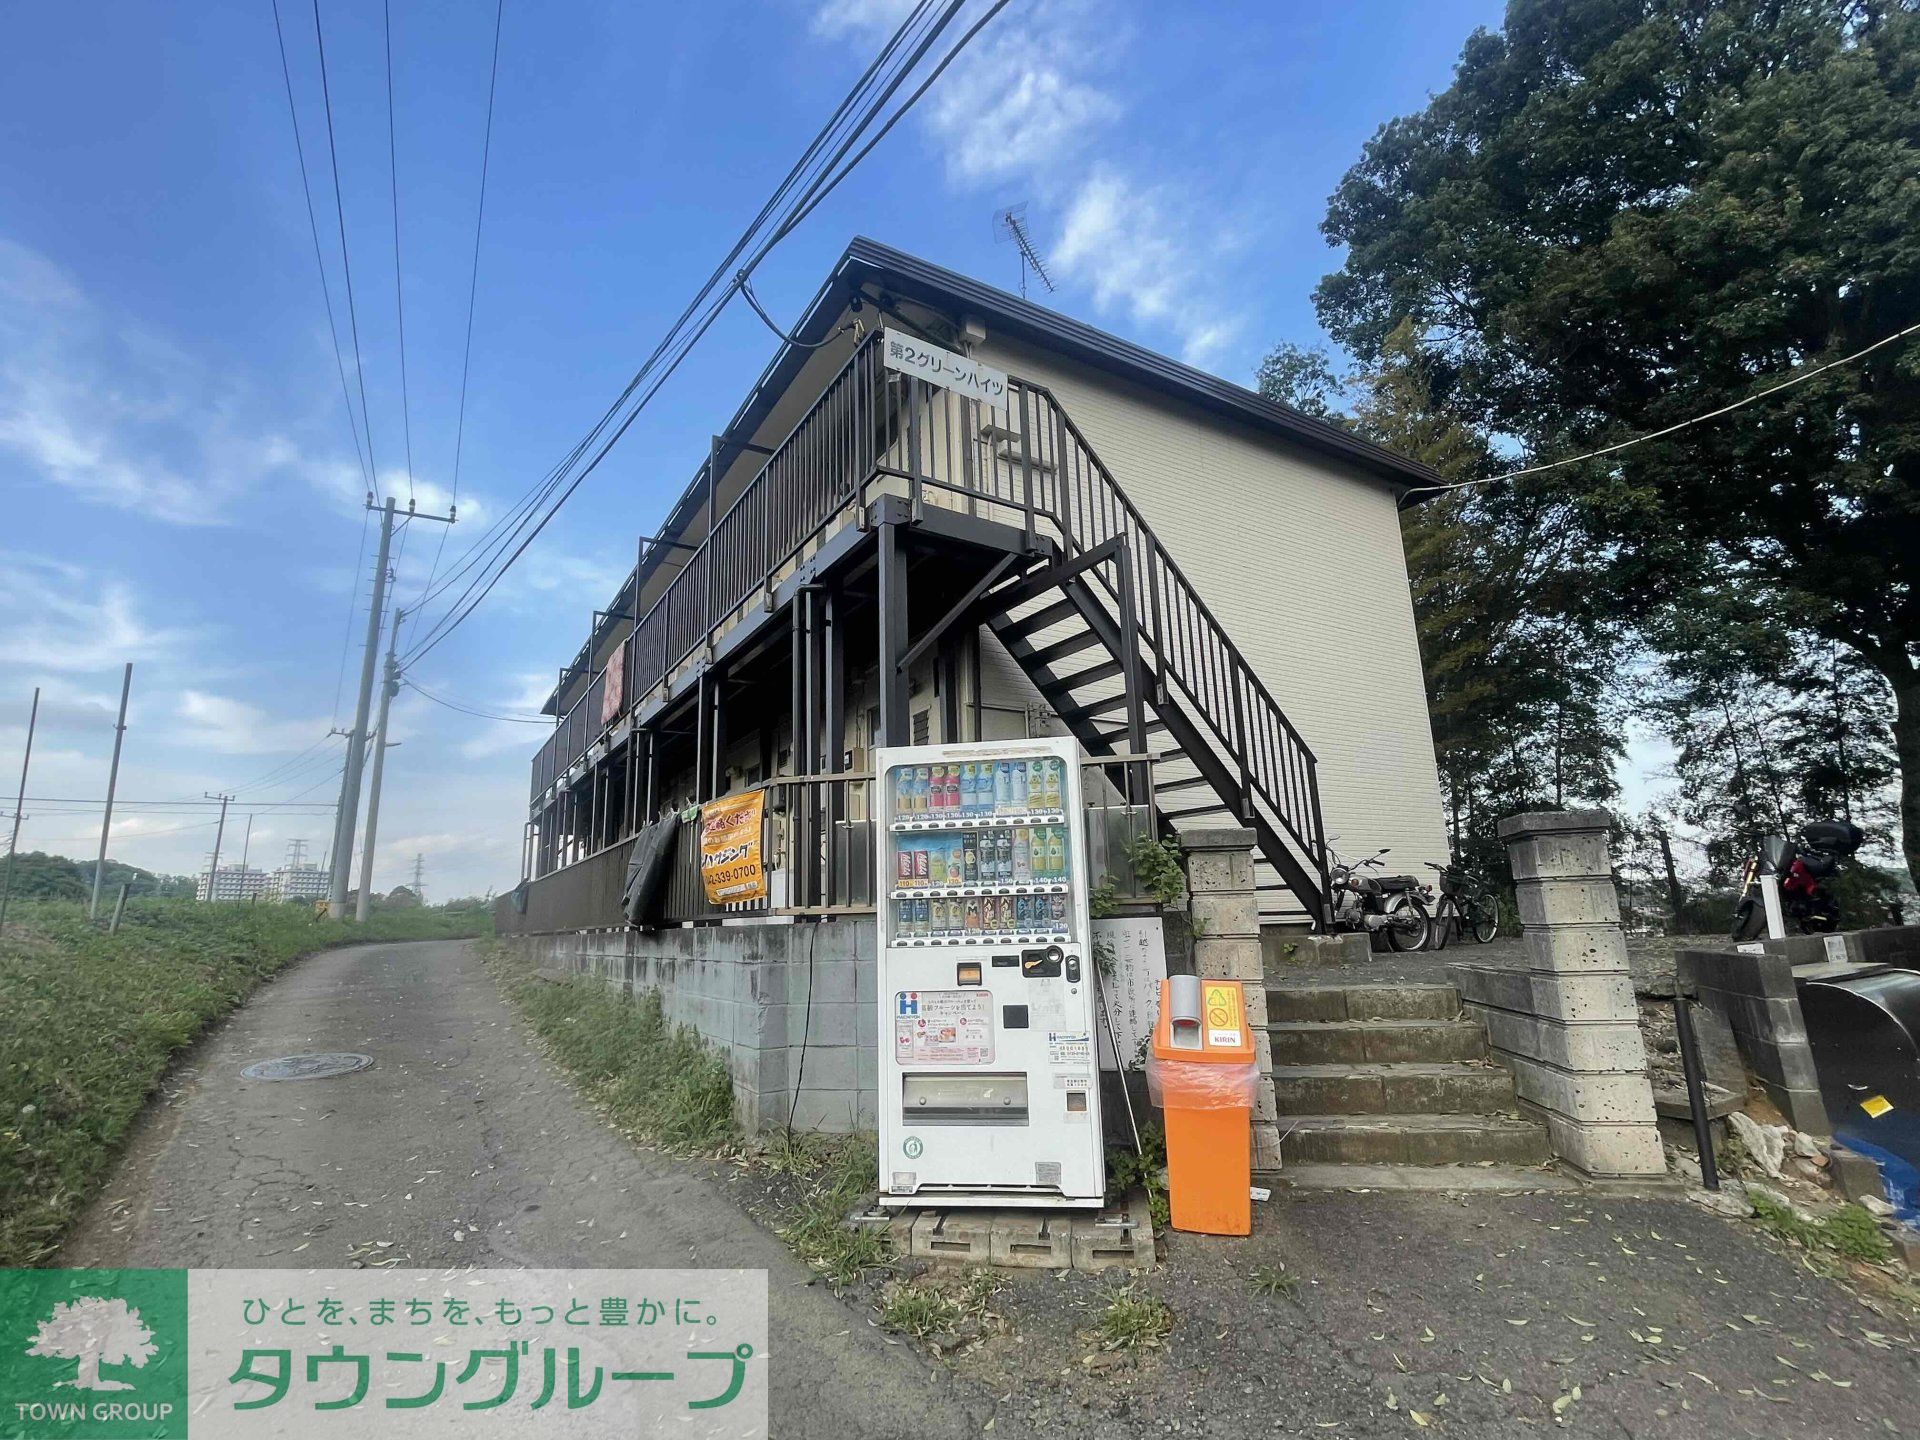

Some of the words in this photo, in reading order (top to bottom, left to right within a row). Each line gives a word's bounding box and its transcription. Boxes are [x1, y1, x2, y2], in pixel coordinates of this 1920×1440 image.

[889, 340, 1004, 396] 第2グリーンハイツ
[707, 864, 756, 885] 2-339-0700
[1214, 1036, 1237, 1044] KIRIN
